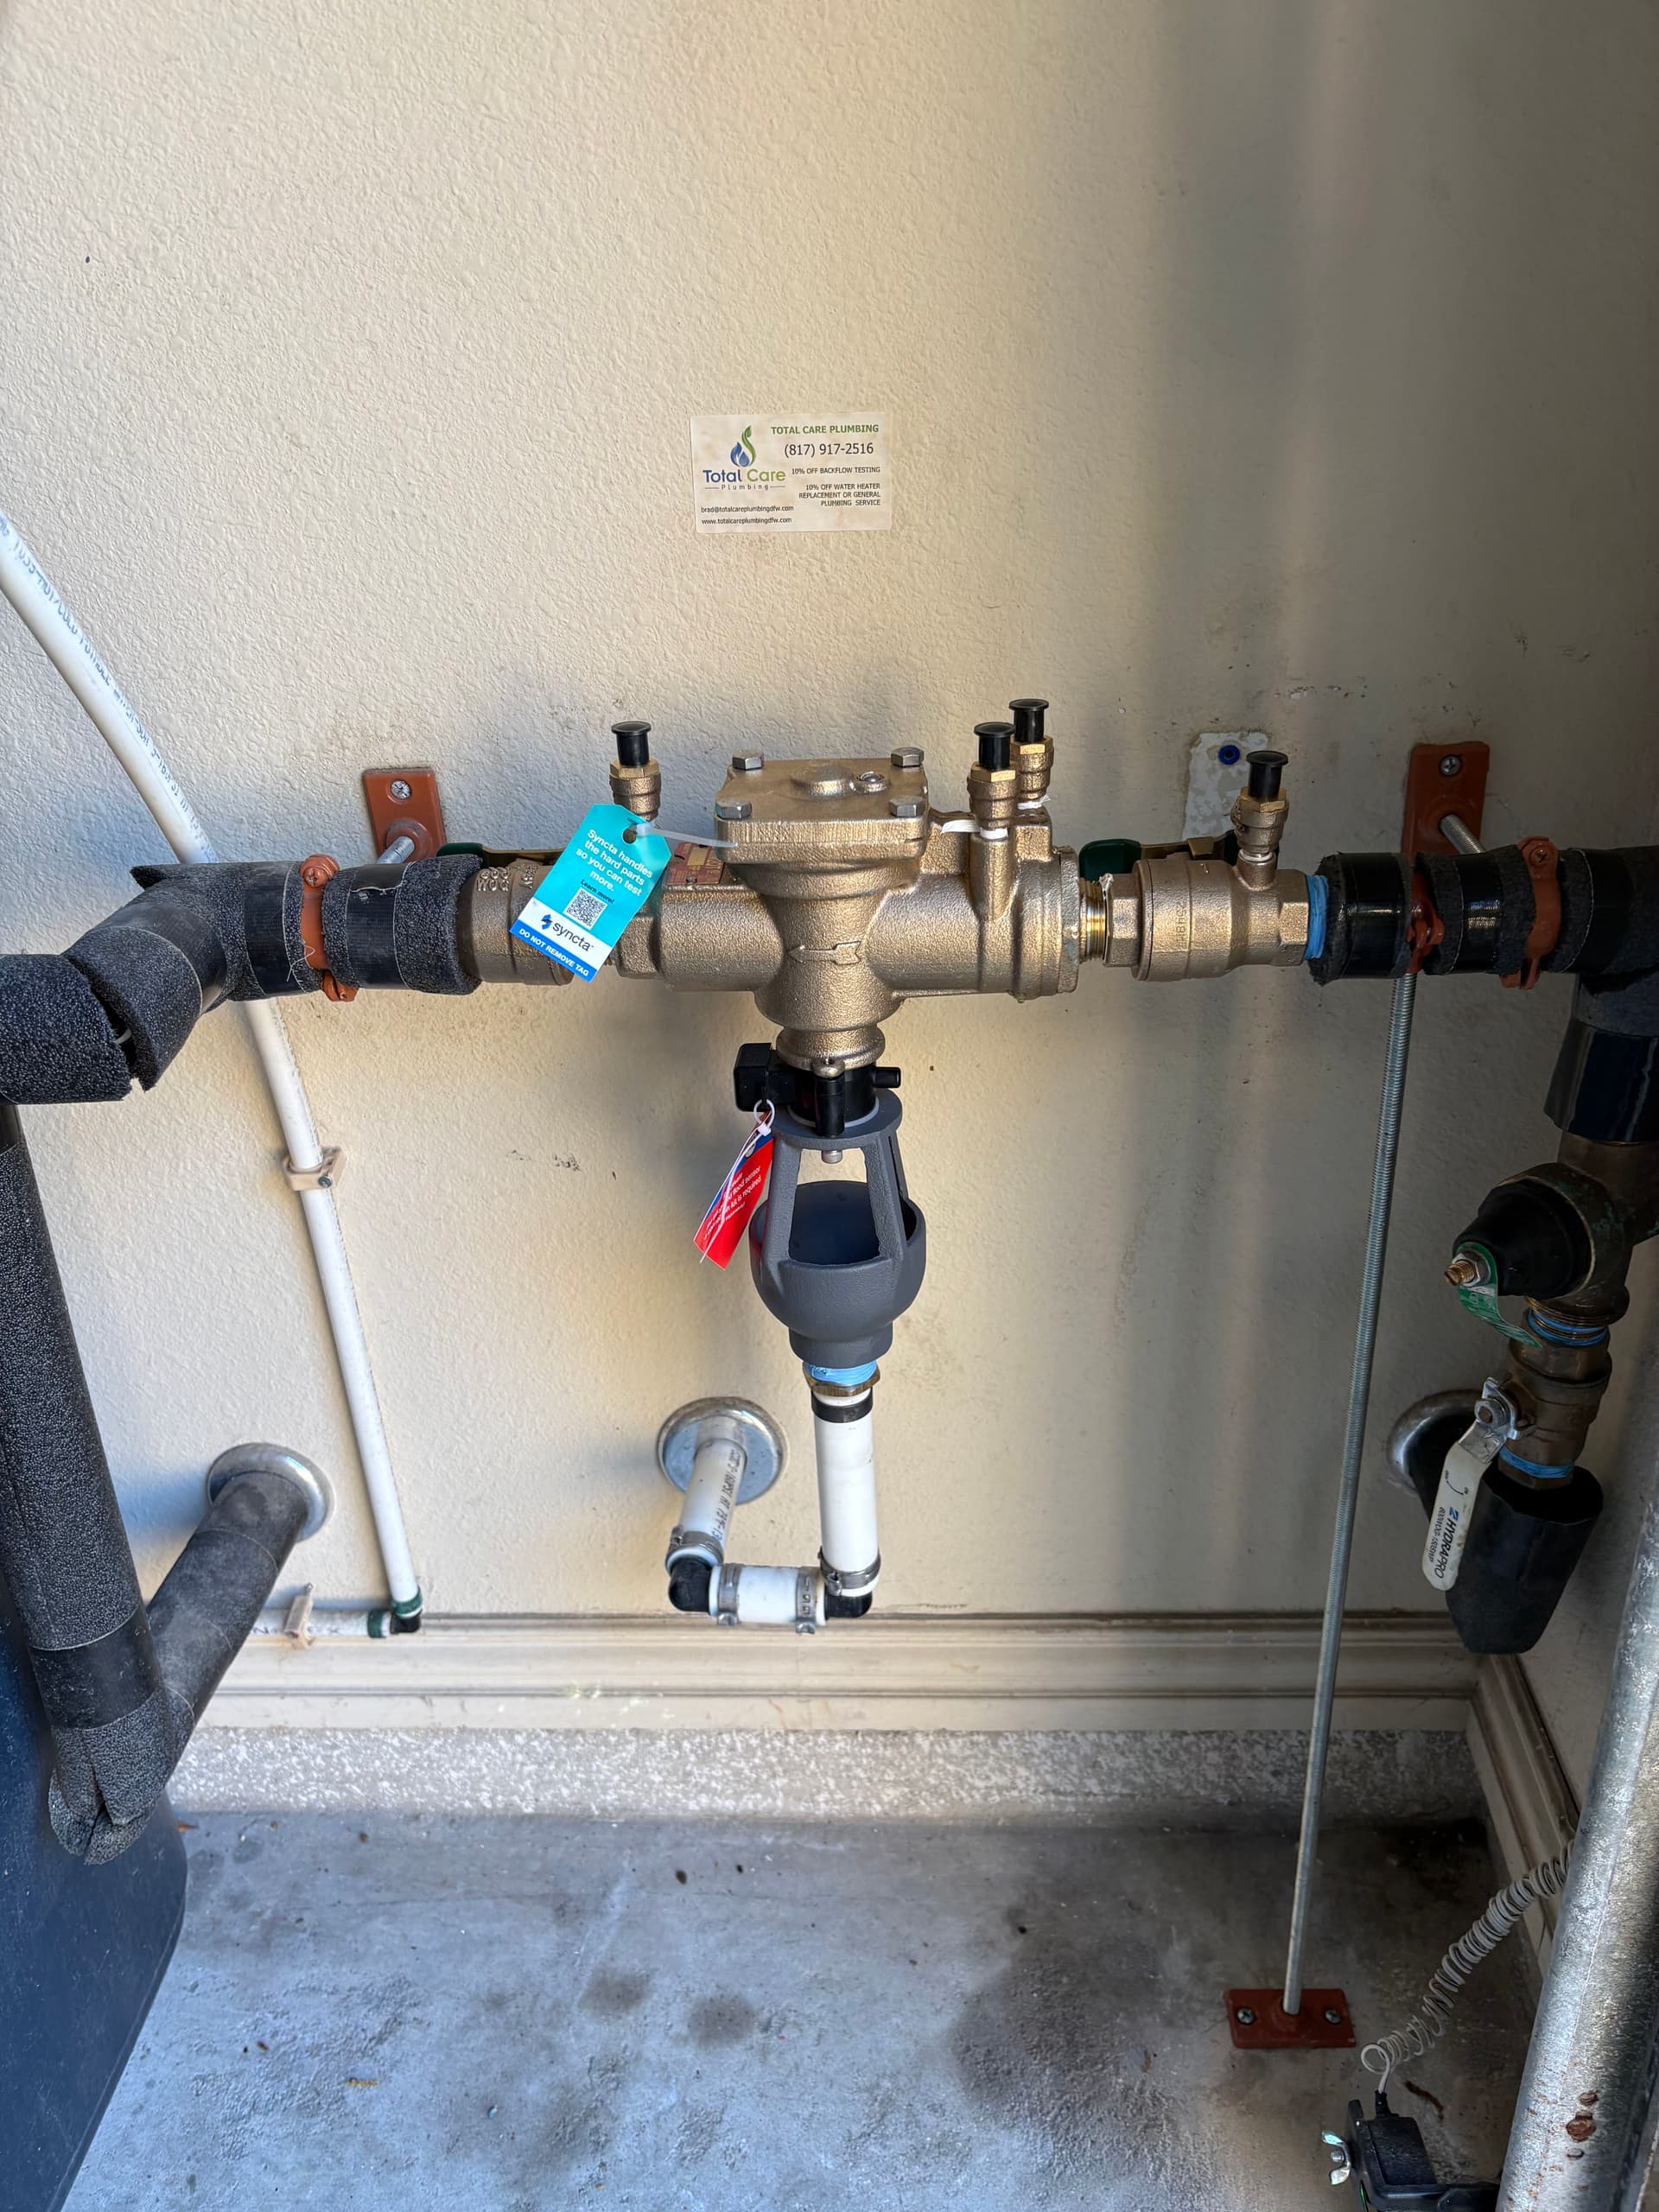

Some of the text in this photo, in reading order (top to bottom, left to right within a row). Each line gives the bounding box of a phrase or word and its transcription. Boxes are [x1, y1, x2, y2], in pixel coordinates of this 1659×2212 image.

[803, 425, 827, 434] CARE
[830, 424, 879, 433] PLUMBING
[784, 442, 874, 458] (817) 917-2516
[702, 468, 786, 483] Total Care
[701, 505, 794, 513] brad@totalcareplumbingdfw.com
[702, 517, 792, 525] www.totalcareplumbingdfw.com
[584, 840, 600, 855] the
[600, 848, 620, 869] hard
[620, 865, 645, 887] parts
[588, 829, 617, 855] Syncta
[618, 848, 653, 879] handles
[575, 849, 643, 897] so you can test
[589, 871, 615, 892] more.
[581, 879, 615, 904] Learn more!
[519, 928, 589, 977] DO NOT REMOVE TAG
[742, 1174, 762, 1198] required
[1434, 1517, 1458, 1580] HYDRAPRO
